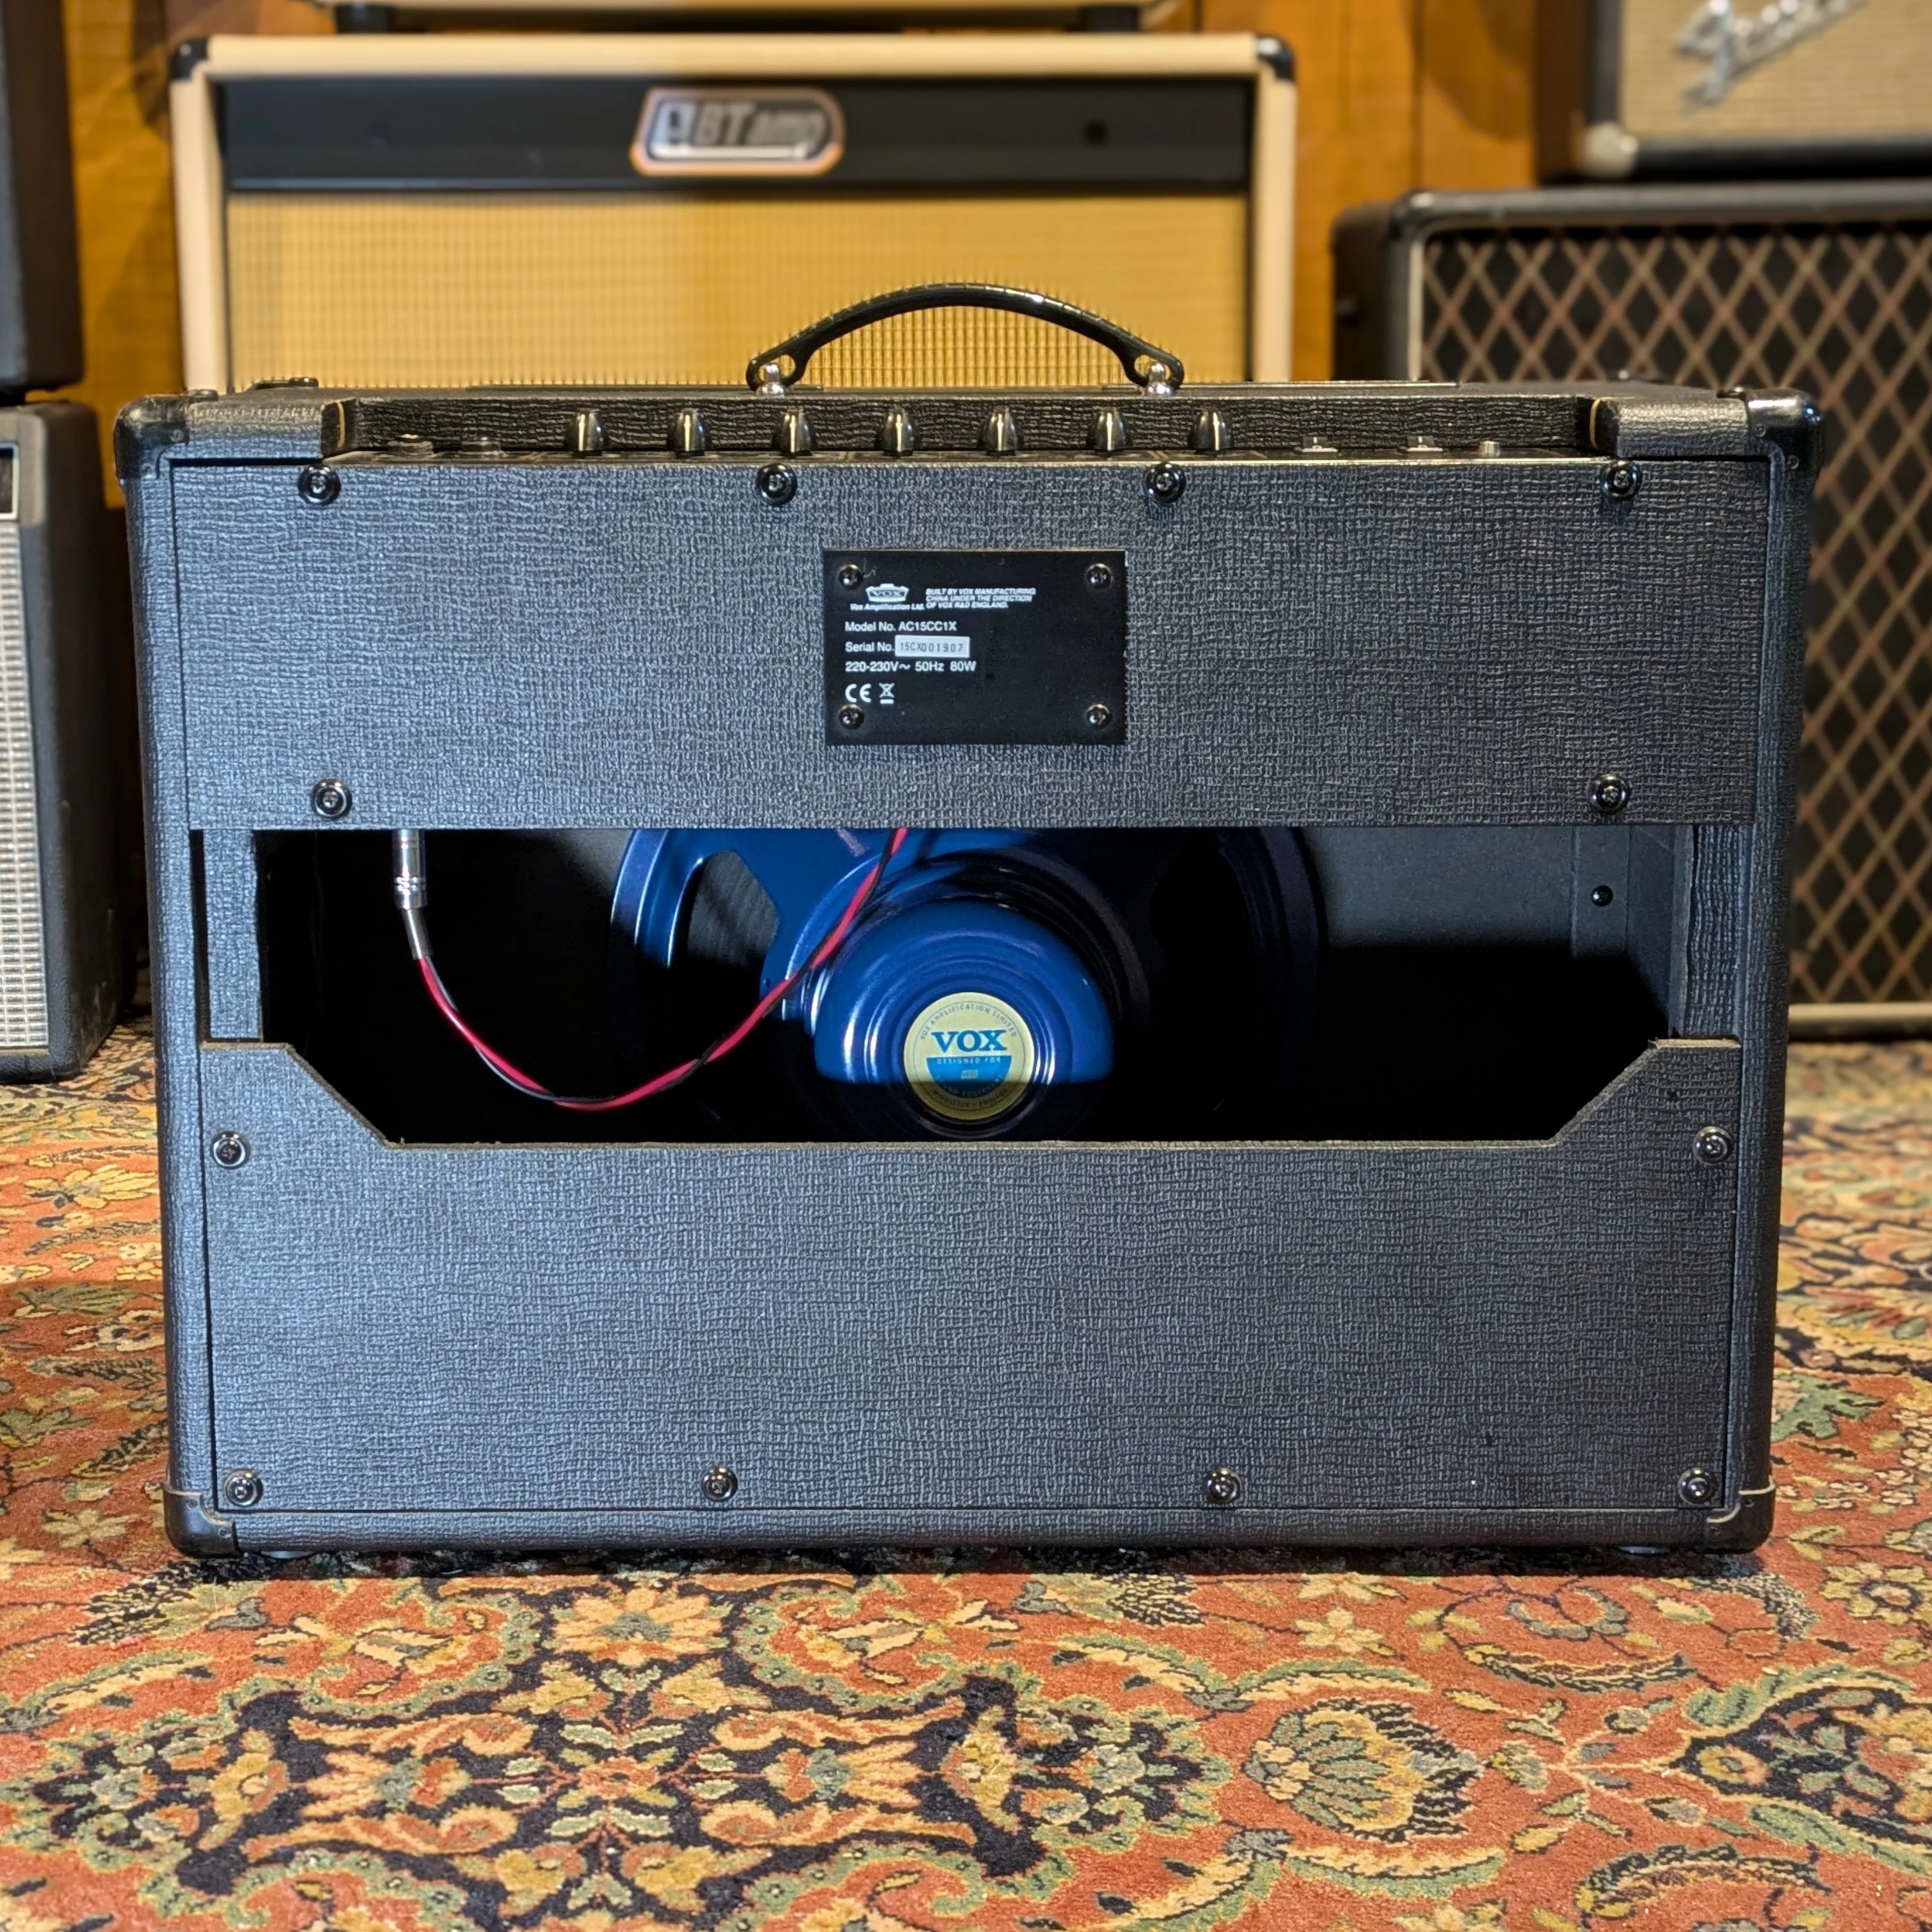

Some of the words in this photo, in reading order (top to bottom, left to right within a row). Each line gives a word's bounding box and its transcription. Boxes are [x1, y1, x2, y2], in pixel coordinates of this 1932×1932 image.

[845, 622, 876, 632] Model
[879, 622, 896, 632] No.
[898, 621, 957, 631] AC15CC1X
[845, 642, 875, 652] Serial
[877, 642, 895, 652] No.
[914, 661, 944, 672] 50Hz
[950, 661, 977, 672] 80W
[920, 1027, 930, 1040] VOX
[931, 1003, 990, 1025] AMPLIFICATION
[992, 1011, 1017, 1036] LIMITED
[931, 1029, 1007, 1053] VOX
